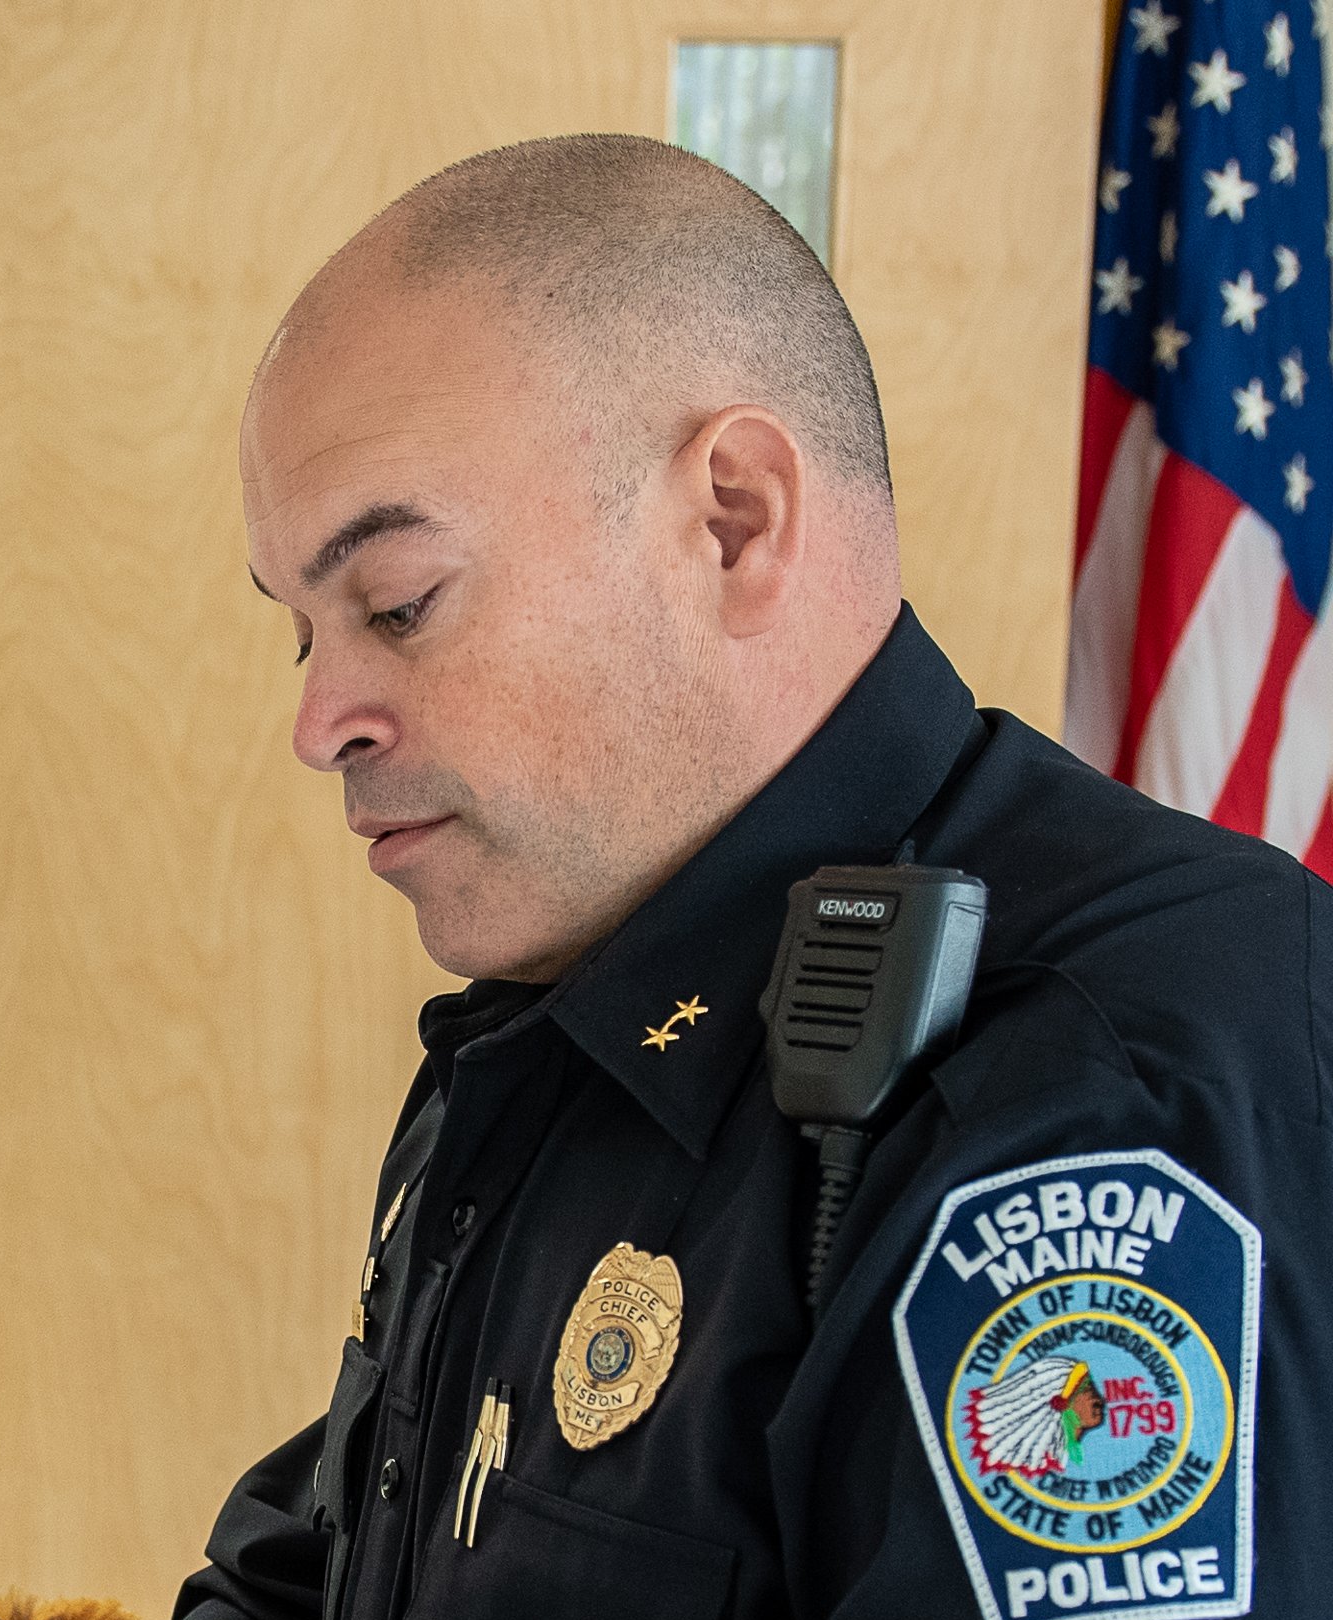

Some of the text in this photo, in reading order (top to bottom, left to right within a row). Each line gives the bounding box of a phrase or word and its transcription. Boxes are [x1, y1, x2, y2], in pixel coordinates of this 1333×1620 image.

[817, 899, 885, 919] KENWOOD
[941, 1180, 1185, 1281] LISBON
[983, 1229, 1152, 1297] MAINE
[600, 1301, 648, 1324] CHIEF
[603, 1281, 661, 1312] POLICE
[964, 1284, 1192, 1378] TOWN OF LISBON
[567, 1375, 623, 1407] LISBON
[575, 1410, 593, 1427] ME
[1108, 1401, 1176, 1438] 1799
[984, 1452, 1213, 1541] STATE OF MAINE
[1004, 1546, 1225, 1619] POLICE
